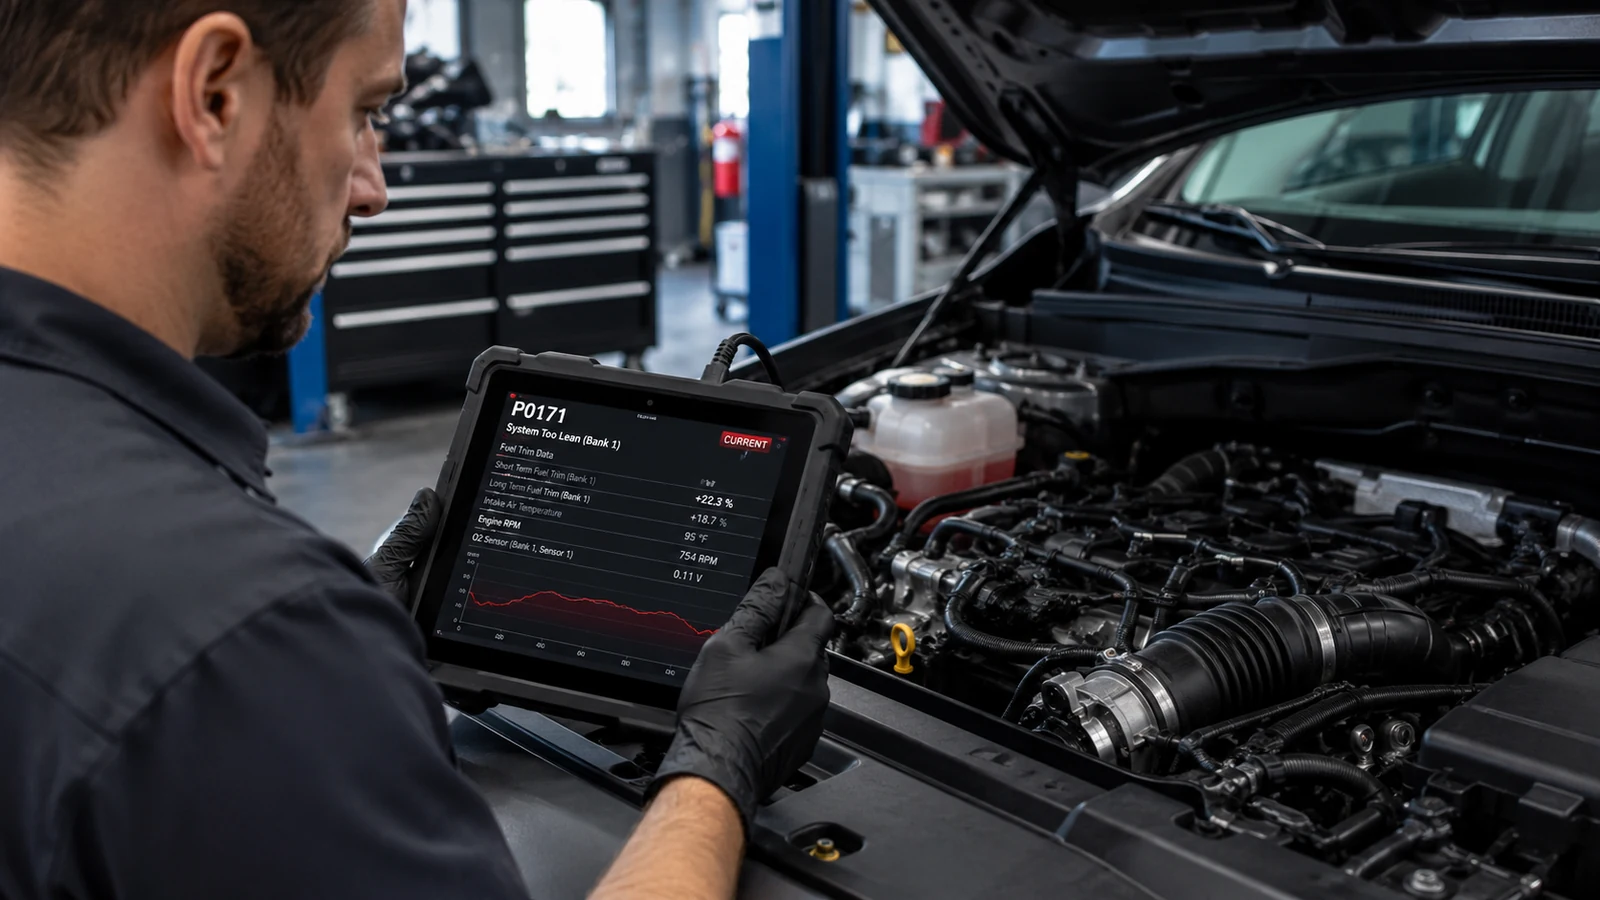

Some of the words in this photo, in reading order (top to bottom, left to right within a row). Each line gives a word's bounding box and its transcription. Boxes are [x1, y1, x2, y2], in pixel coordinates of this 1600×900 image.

[511, 400, 566, 423] P0171
[506, 422, 539, 436] System
[541, 428, 557, 439] Too
[559, 432, 581, 443] Lean
[582, 435, 609, 448] (Bank
[611, 440, 621, 451] 1)
[723, 435, 769, 449] CURRENT
[500, 442, 517, 453] Fuel
[518, 445, 535, 456] Trim
[535, 449, 554, 460] Data
[494, 460, 514, 471] Short
[533, 467, 549, 477] Fuel
[550, 470, 566, 480] Trim
[589, 477, 597, 487] 1)
[488, 478, 507, 490] Long
[508, 482, 526, 492] Term
[526, 485, 542, 495] Fuel
[543, 488, 560, 498] Trim
[560, 490, 581, 502] (Bank
[583, 495, 591, 504] 1)
[483, 496, 506, 508] Intake
[506, 500, 517, 509] Air
[519, 502, 563, 518] Temperature
[695, 494, 723, 507] +22.3
[725, 498, 734, 508] %
[477, 514, 502, 527] Engine
[503, 519, 521, 529] RPM
[690, 514, 717, 525] +18.7
[719, 517, 727, 527] %
[699, 533, 709, 543] °F
[484, 535, 508, 547] Sensor
[509, 539, 530, 551] (Bank
[531, 544, 537, 553] 1,
[539, 545, 565, 557] Sensor
[566, 550, 574, 560] 1)
[679, 550, 697, 561] 754
[698, 554, 718, 565] RPM
[673, 569, 694, 581] 0.11
[696, 573, 703, 583] V
